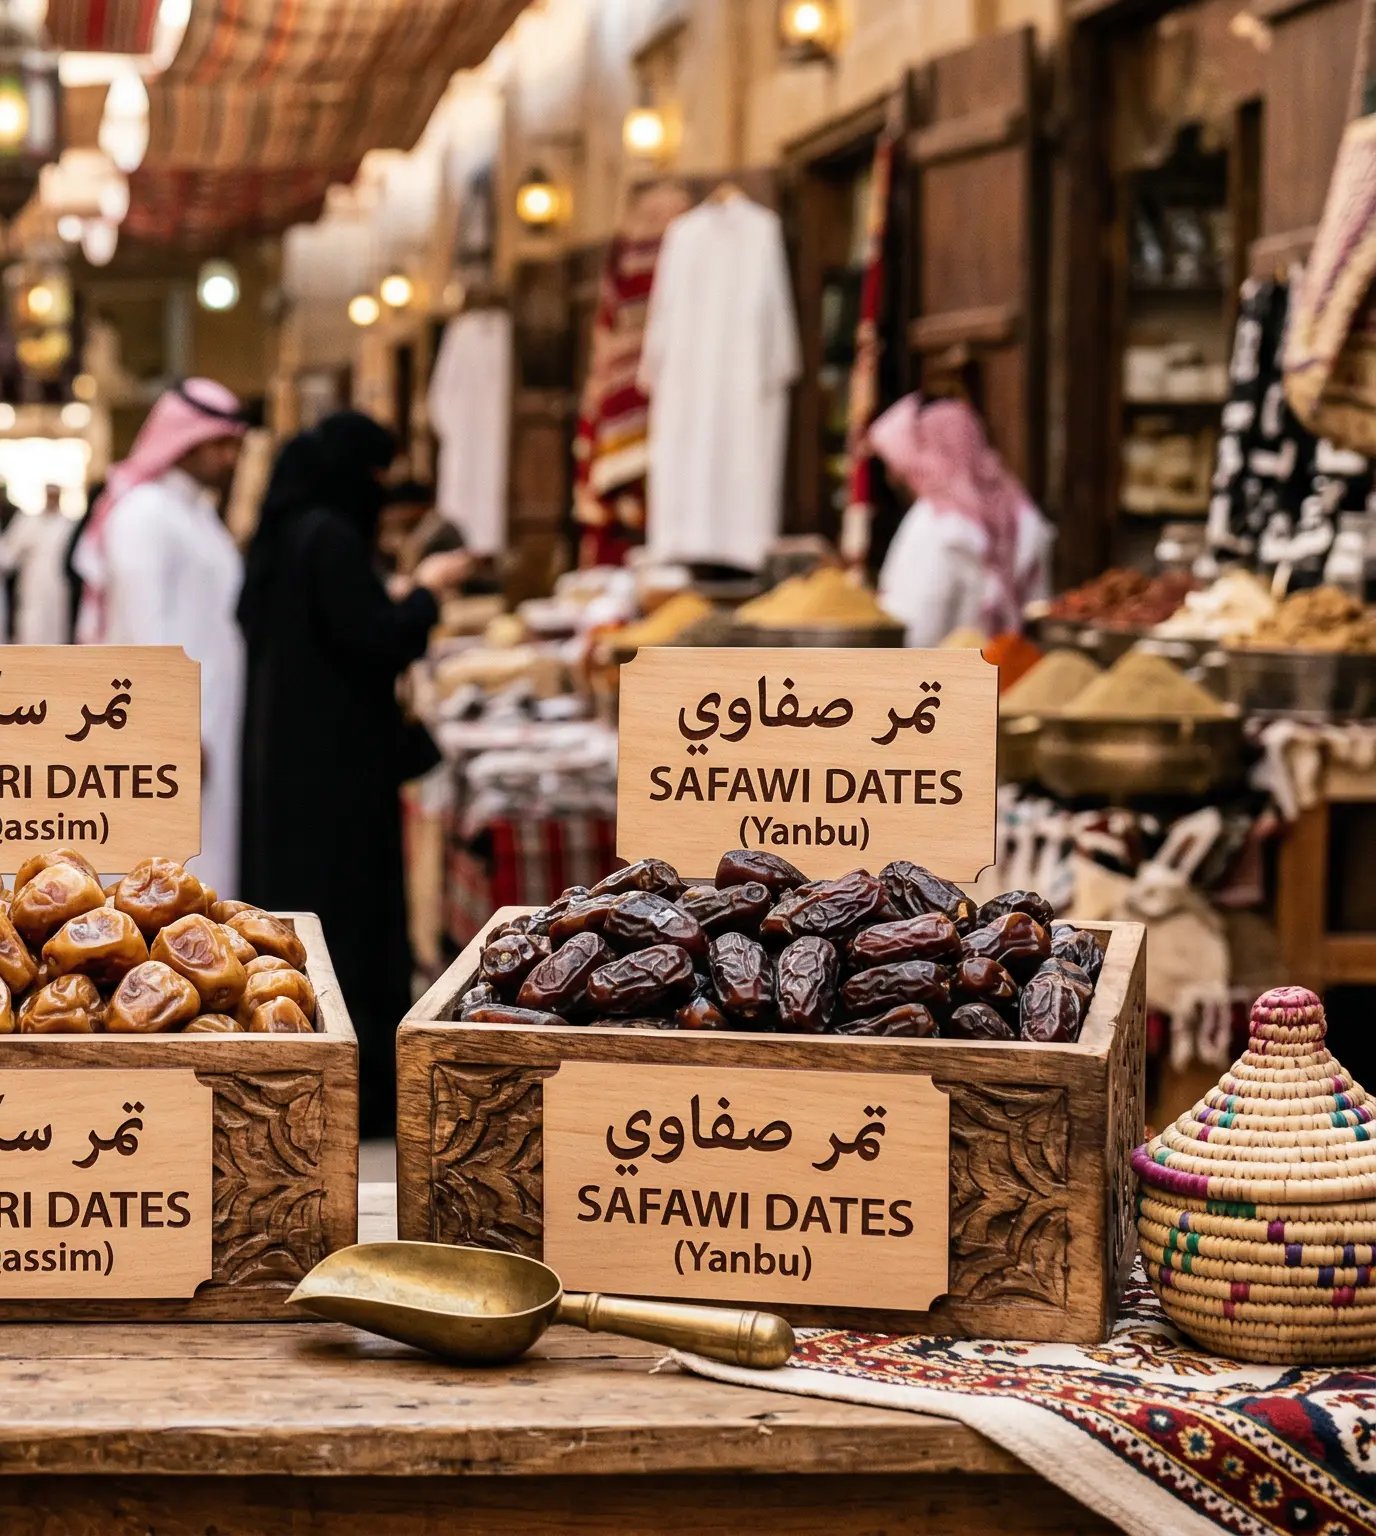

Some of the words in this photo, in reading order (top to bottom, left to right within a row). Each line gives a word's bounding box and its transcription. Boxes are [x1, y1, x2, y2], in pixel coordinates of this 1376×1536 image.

[64, 678, 133, 742] تمر
[678, 675, 854, 757] صفاوي
[870, 680, 942, 746] تمر
[47, 763, 179, 799] DATES
[649, 765, 810, 803] SAFAWI
[825, 768, 963, 806] DATES
[739, 815, 870, 851] (Yanbu)
[71, 1101, 146, 1169] تمر
[605, 1094, 793, 1177] صفاوي
[811, 1105, 888, 1172] تمر
[48, 1190, 191, 1229] DATES
[576, 1184, 749, 1230] SAFAWI
[765, 1193, 914, 1238] DATES
[674, 1239, 812, 1282] (Yanbu)
